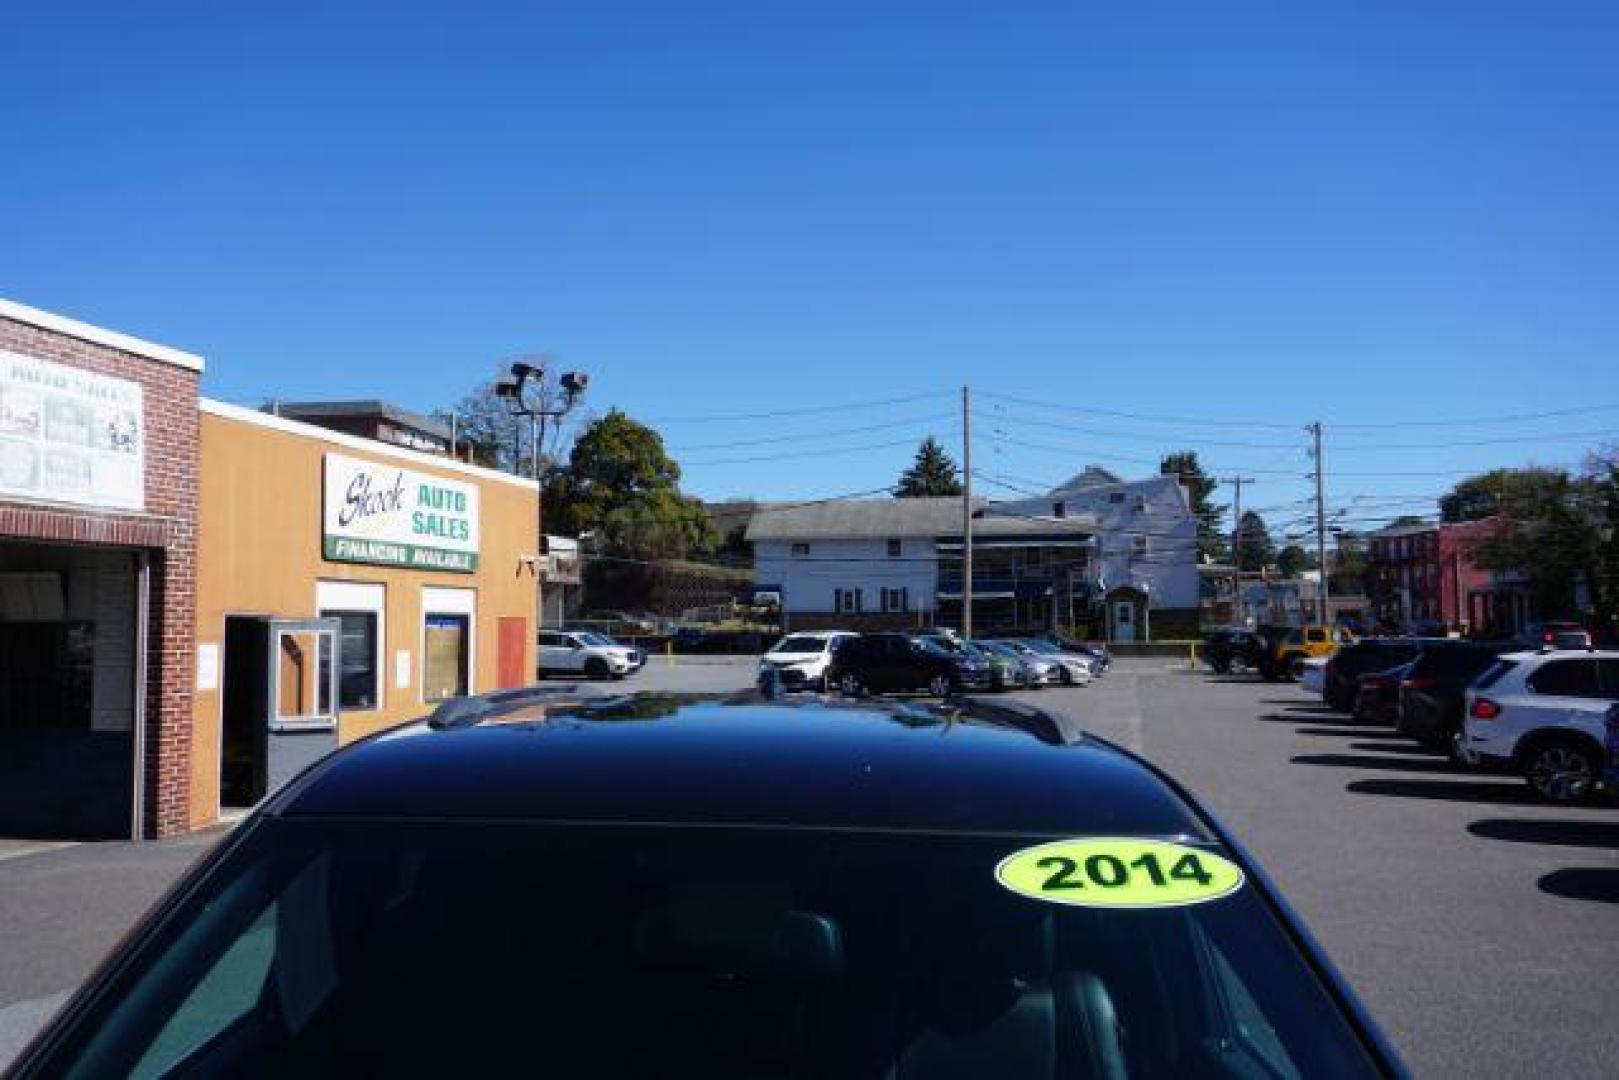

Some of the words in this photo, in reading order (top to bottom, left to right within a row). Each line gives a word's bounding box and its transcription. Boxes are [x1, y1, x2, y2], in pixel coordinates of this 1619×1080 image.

[418, 483, 466, 512] AUTO
[412, 510, 469, 541] SALES
[1036, 852, 1213, 891] 2014
